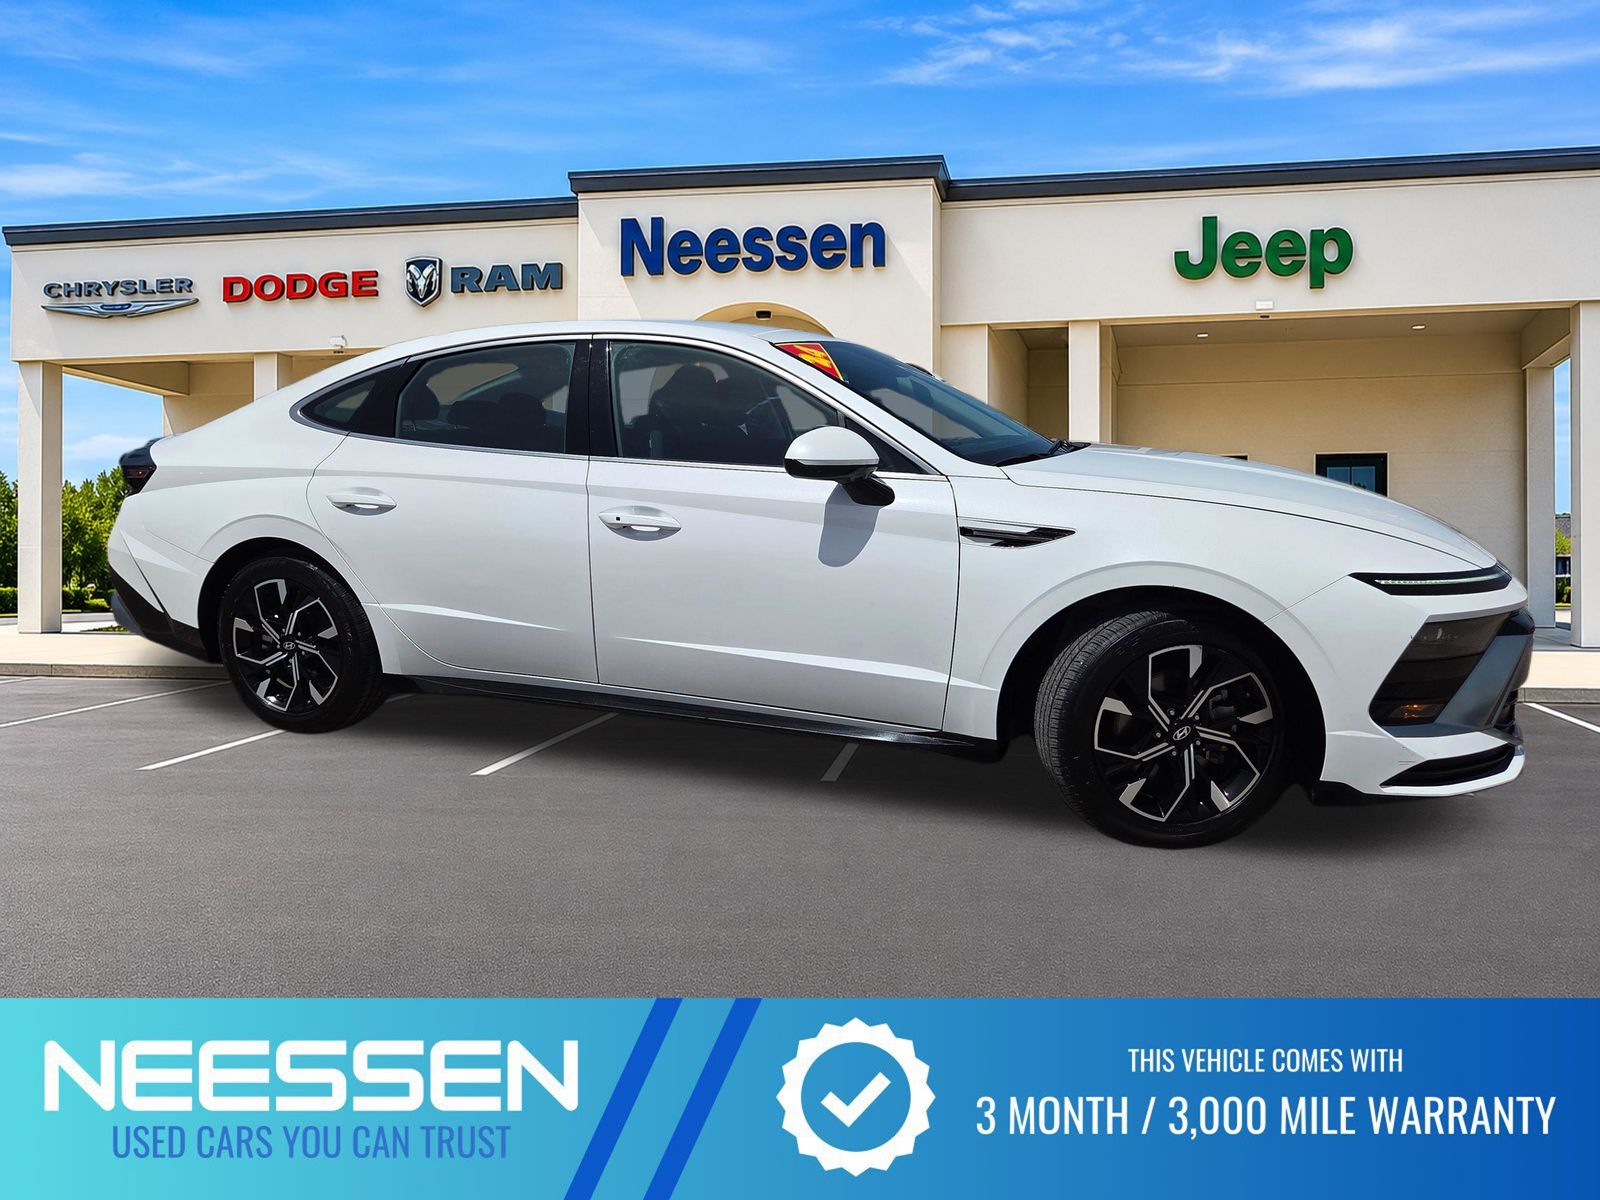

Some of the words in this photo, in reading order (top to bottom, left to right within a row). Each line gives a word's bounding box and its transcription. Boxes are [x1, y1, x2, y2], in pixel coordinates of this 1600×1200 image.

[620, 216, 887, 277] Neessen
[1174, 216, 1355, 289] Jeep
[43, 278, 194, 299] CHRYSLER
[222, 270, 379, 303] DODGE
[450, 262, 564, 296] RAM
